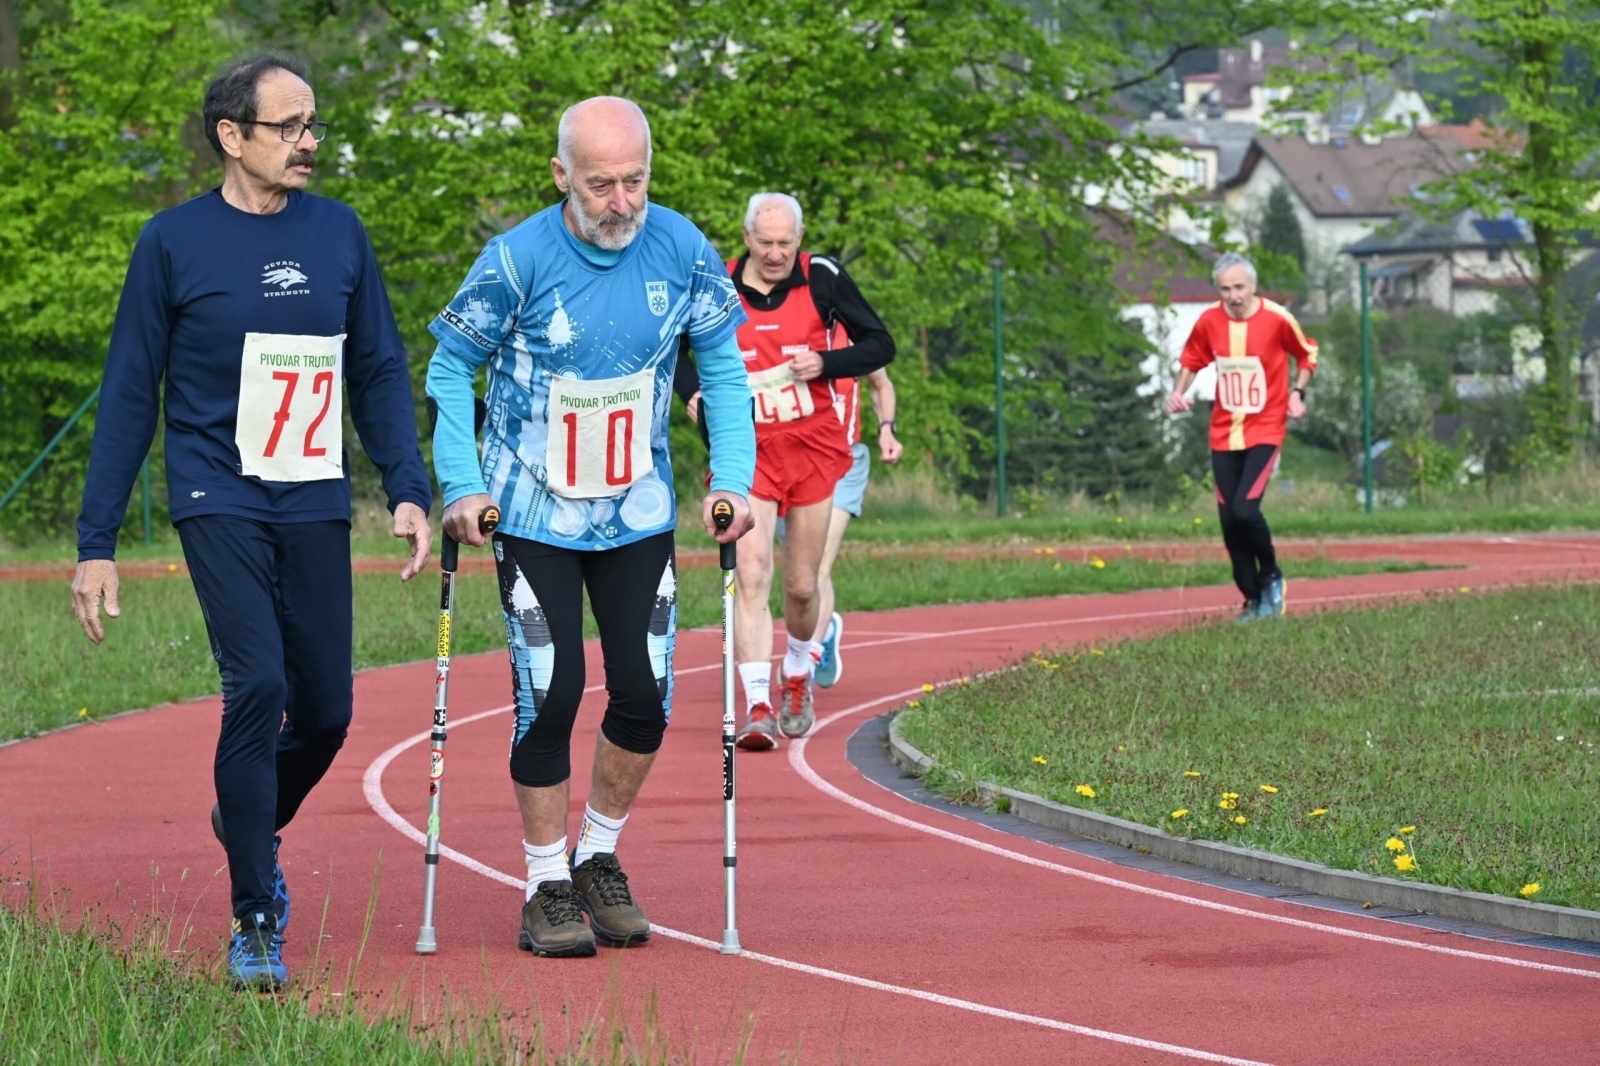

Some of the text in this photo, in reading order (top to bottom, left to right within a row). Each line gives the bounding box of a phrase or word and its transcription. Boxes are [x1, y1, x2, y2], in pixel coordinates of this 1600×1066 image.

[263, 260, 301, 271] NEVADA
[263, 289, 310, 298] STRENGTH
[260, 353, 337, 368] PIVOVAR TRUTNOV
[560, 388, 641, 408] PIVOVAR TRUTNOV
[1221, 371, 1260, 406] 106
[262, 371, 334, 458] 72
[438, 615, 446, 653] SENSOR
